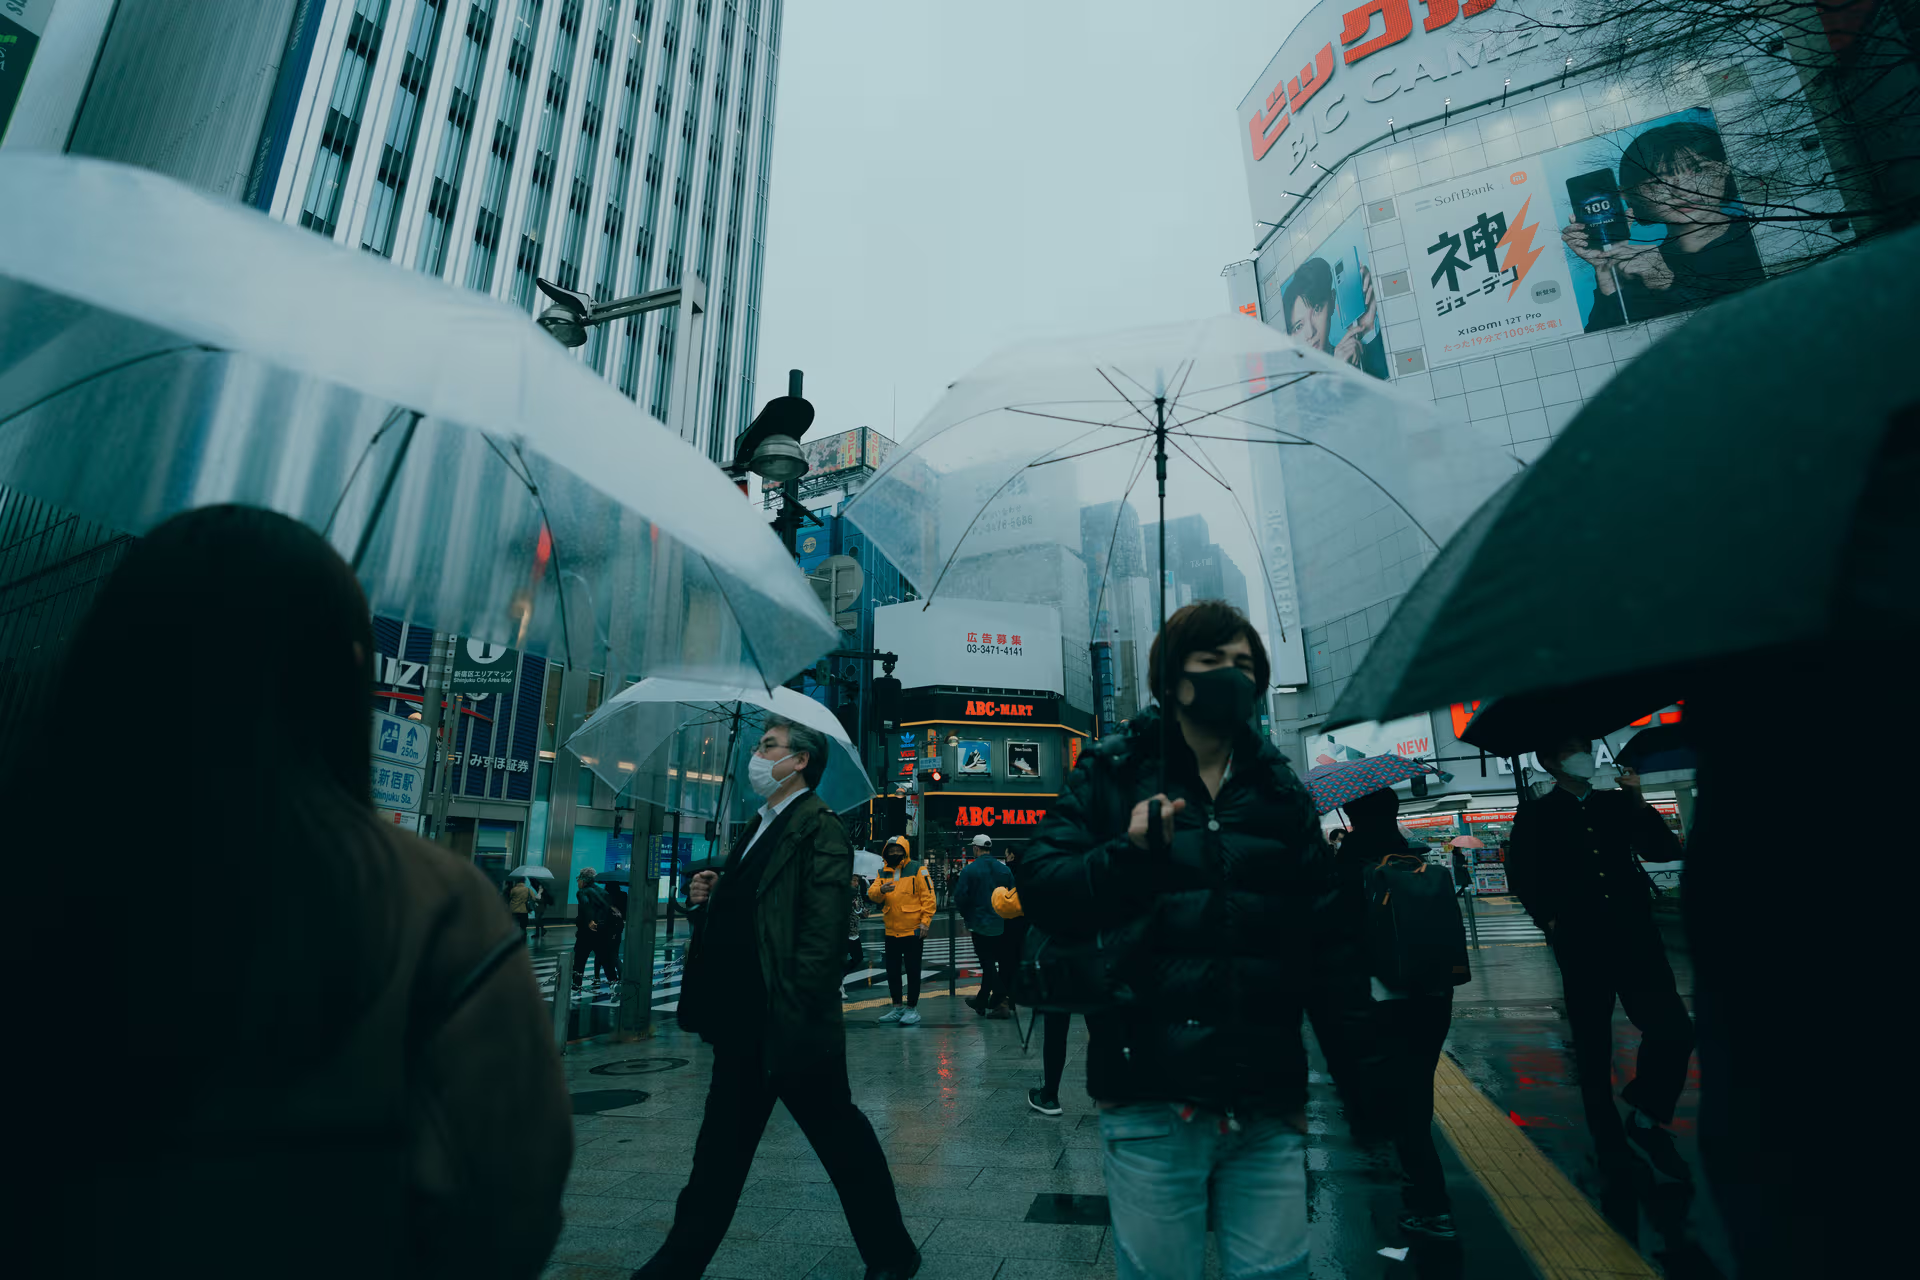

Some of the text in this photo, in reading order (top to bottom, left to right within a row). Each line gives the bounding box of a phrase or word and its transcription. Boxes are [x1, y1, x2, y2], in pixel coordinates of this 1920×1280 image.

[1434, 181, 1495, 208] SoftBank
[1584, 200, 1611, 215] 100
[1505, 315, 1522, 326] 12T
[1525, 312, 1542, 321] Pro
[966, 632, 1023, 646] 広告募集
[966, 643, 1023, 657] 03-3471-4141
[453, 669, 514, 679] 新宿区エリアマップ
[476, 677, 486, 685] City
[965, 699, 1034, 717] ABC-MART
[400, 746, 420, 760] 250m
[1396, 737, 1429, 757] NEW
[469, 753, 530, 773] みずほ証券
